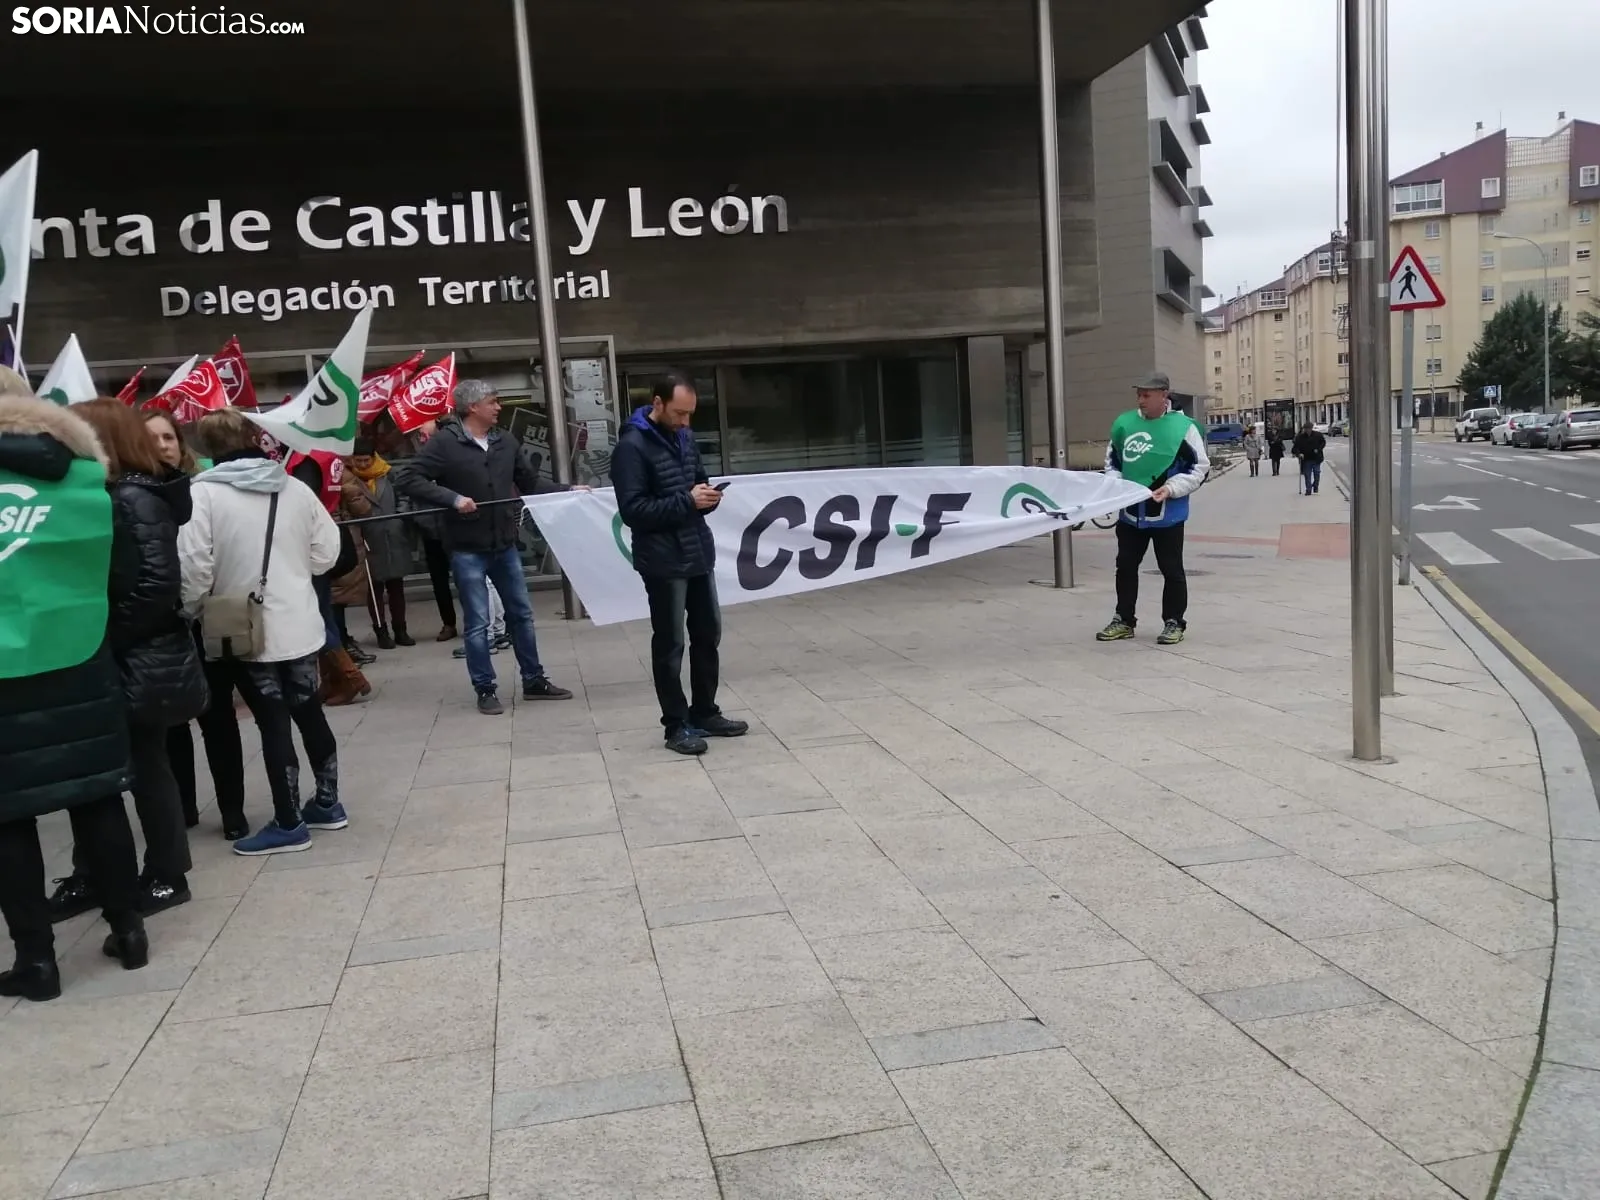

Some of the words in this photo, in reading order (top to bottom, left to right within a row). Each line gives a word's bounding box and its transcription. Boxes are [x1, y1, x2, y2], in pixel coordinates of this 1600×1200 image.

[30, 207, 156, 260] nta
[178, 199, 271, 254] de
[566, 198, 607, 256] y
[628, 184, 790, 239] León
[160, 280, 395, 321] Delegación
[409, 370, 449, 403] UGT
[1127, 441, 1153, 454] CSIF
[0, 505, 52, 534] SIF
